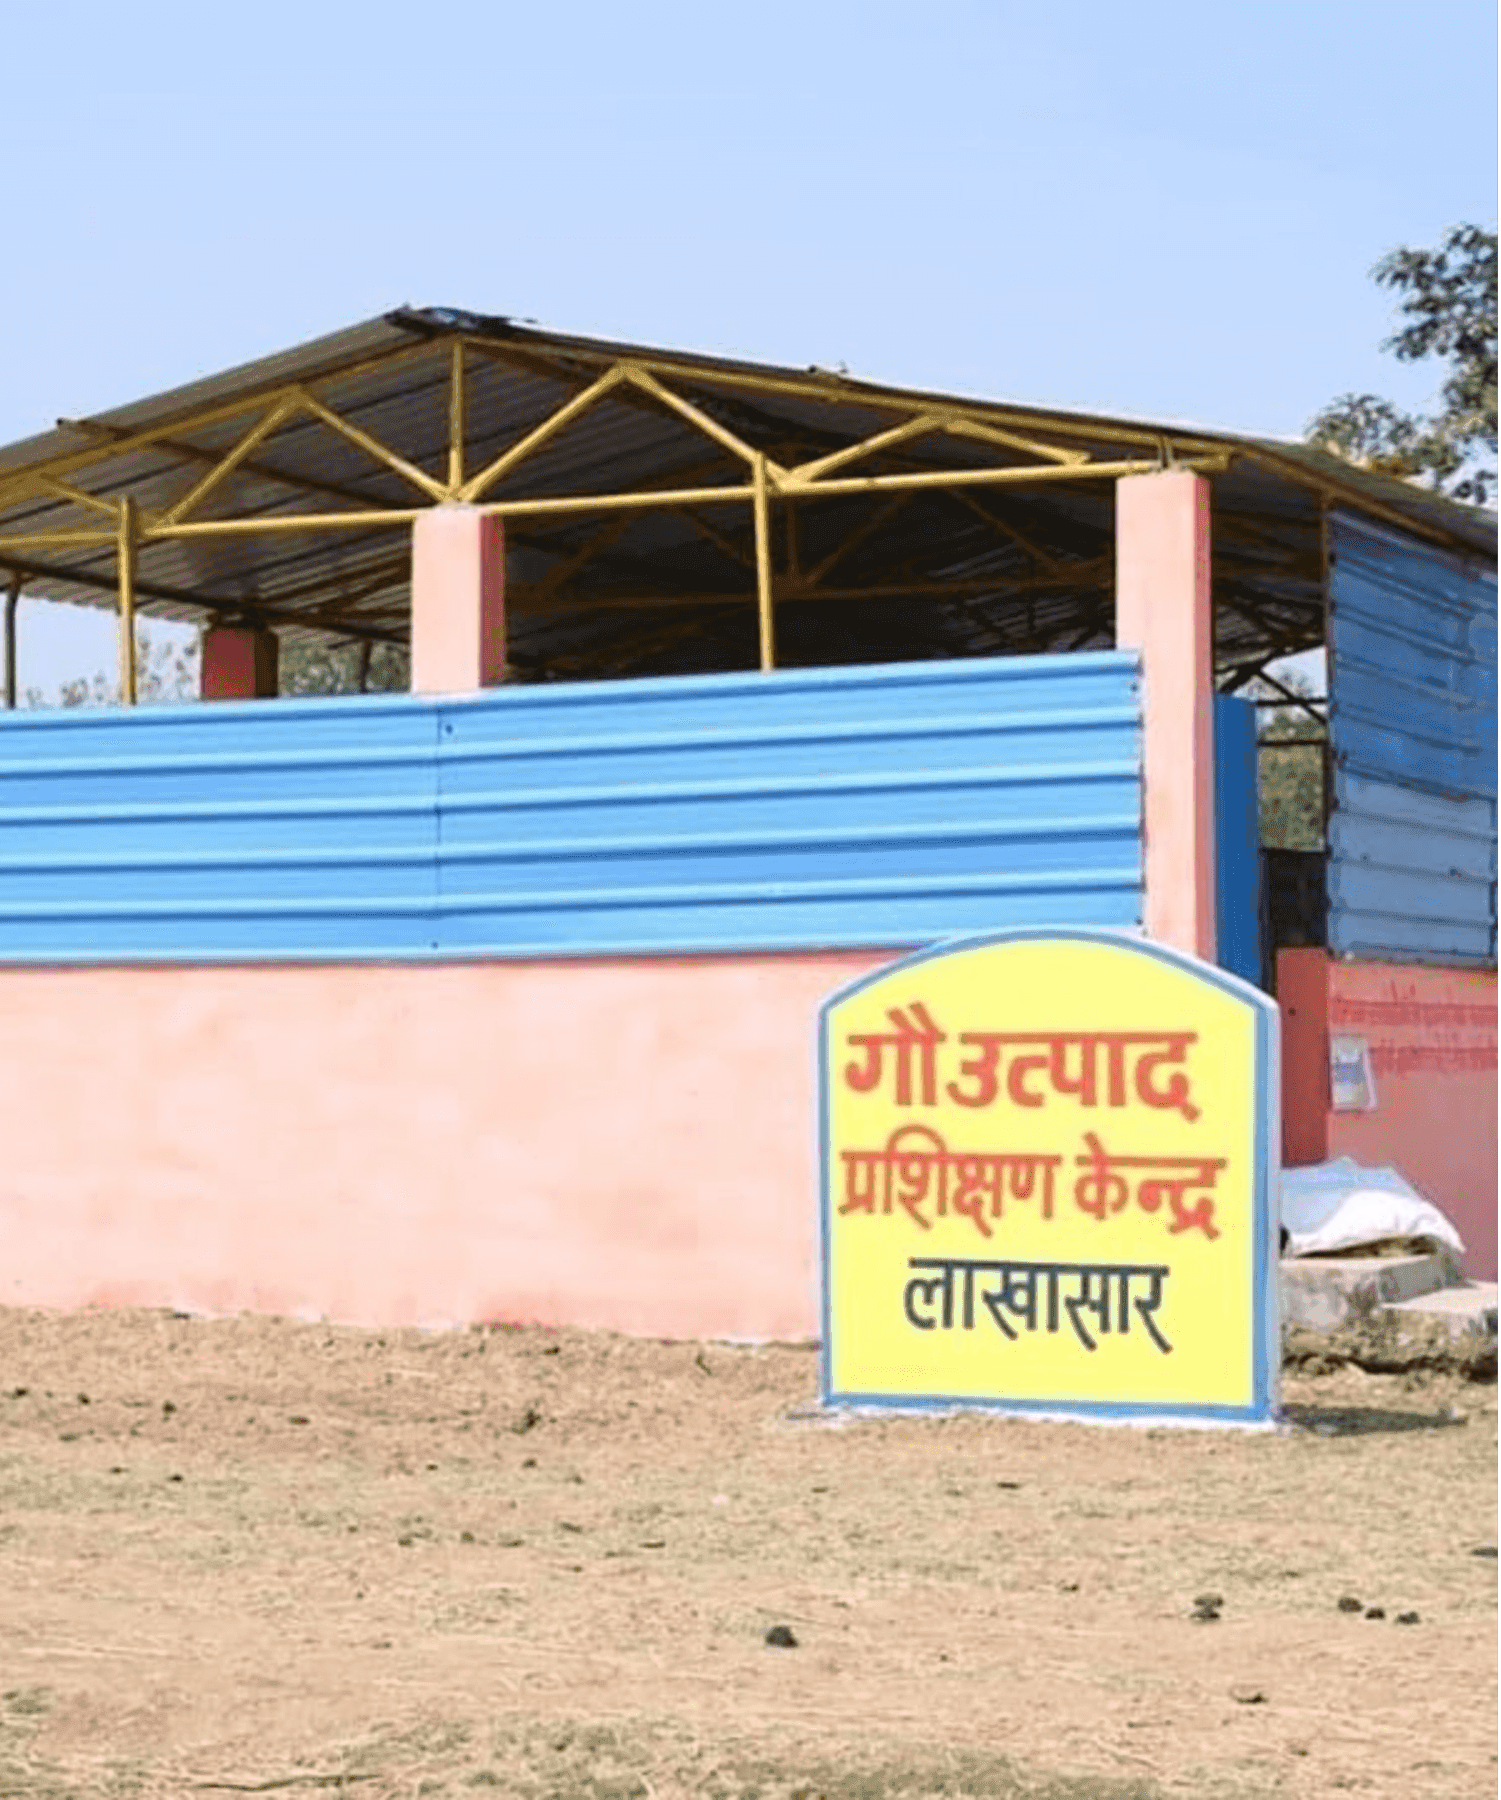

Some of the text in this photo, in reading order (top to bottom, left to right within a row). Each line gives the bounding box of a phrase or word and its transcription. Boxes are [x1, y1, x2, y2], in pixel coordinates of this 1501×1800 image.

[838, 1124, 1227, 1240] प्रशिक्षण केन्द्र
[904, 1257, 1173, 1355] लाखासार
